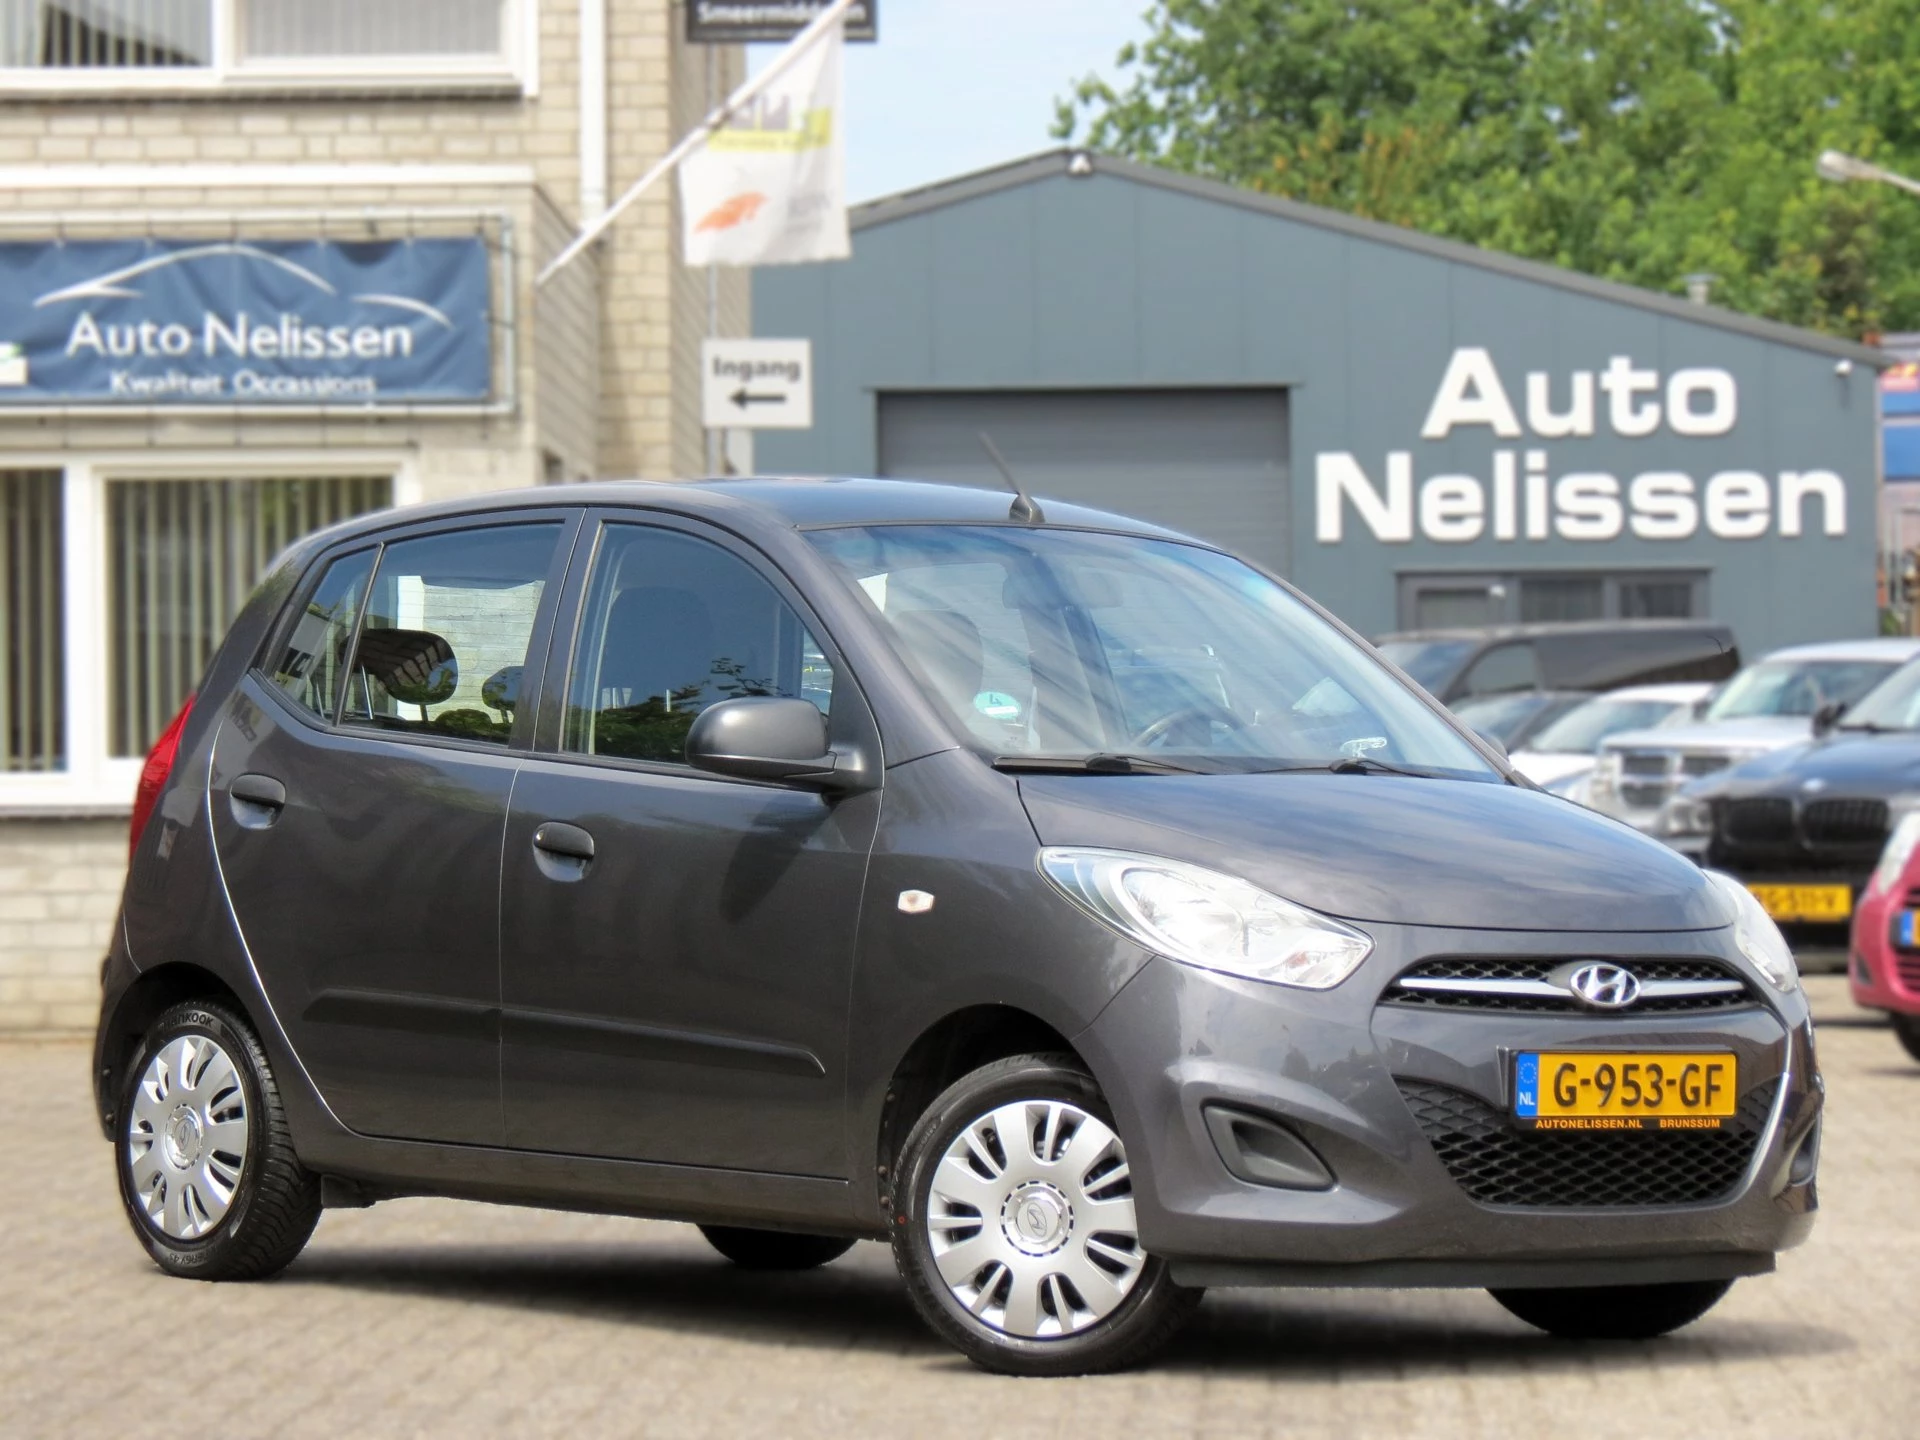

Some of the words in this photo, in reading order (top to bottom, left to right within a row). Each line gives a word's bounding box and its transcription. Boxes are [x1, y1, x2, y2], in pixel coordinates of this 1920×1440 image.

[66, 313, 190, 356] Auto
[204, 313, 412, 358] Nelissen
[713, 356, 800, 382] Ingang
[1420, 347, 1737, 438] Auto
[1315, 450, 1847, 542] Nelissen
[1519, 1091, 1535, 1106] NL
[1554, 1062, 1724, 1107] G-953-GF
[1535, 1119, 1643, 1129] AUTONELISSEN.NL
[1659, 1119, 1721, 1128] BRUNSSUM
